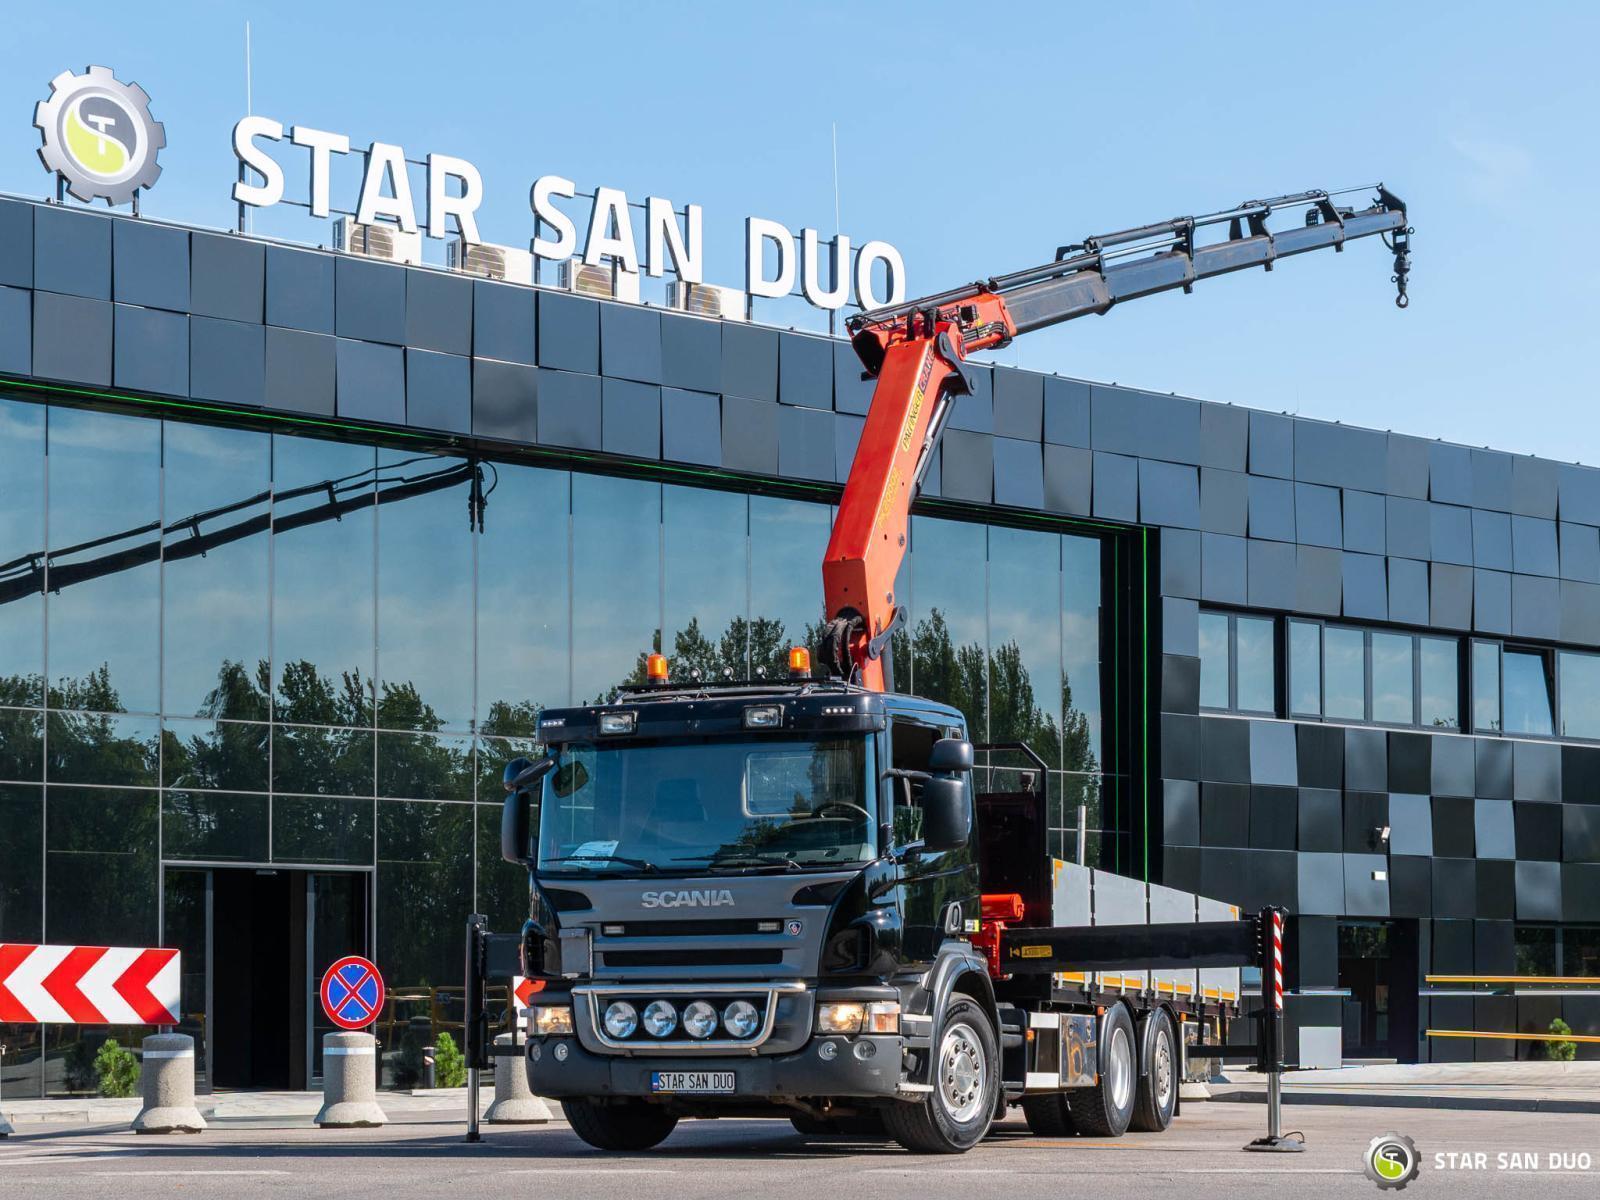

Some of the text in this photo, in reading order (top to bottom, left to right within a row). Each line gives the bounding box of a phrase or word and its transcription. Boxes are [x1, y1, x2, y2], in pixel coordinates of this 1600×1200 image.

[232, 116, 906, 312] STAR SAN DUO
[641, 889, 735, 907] SCANIA
[659, 1074, 734, 1089] STAR SAN DUO
